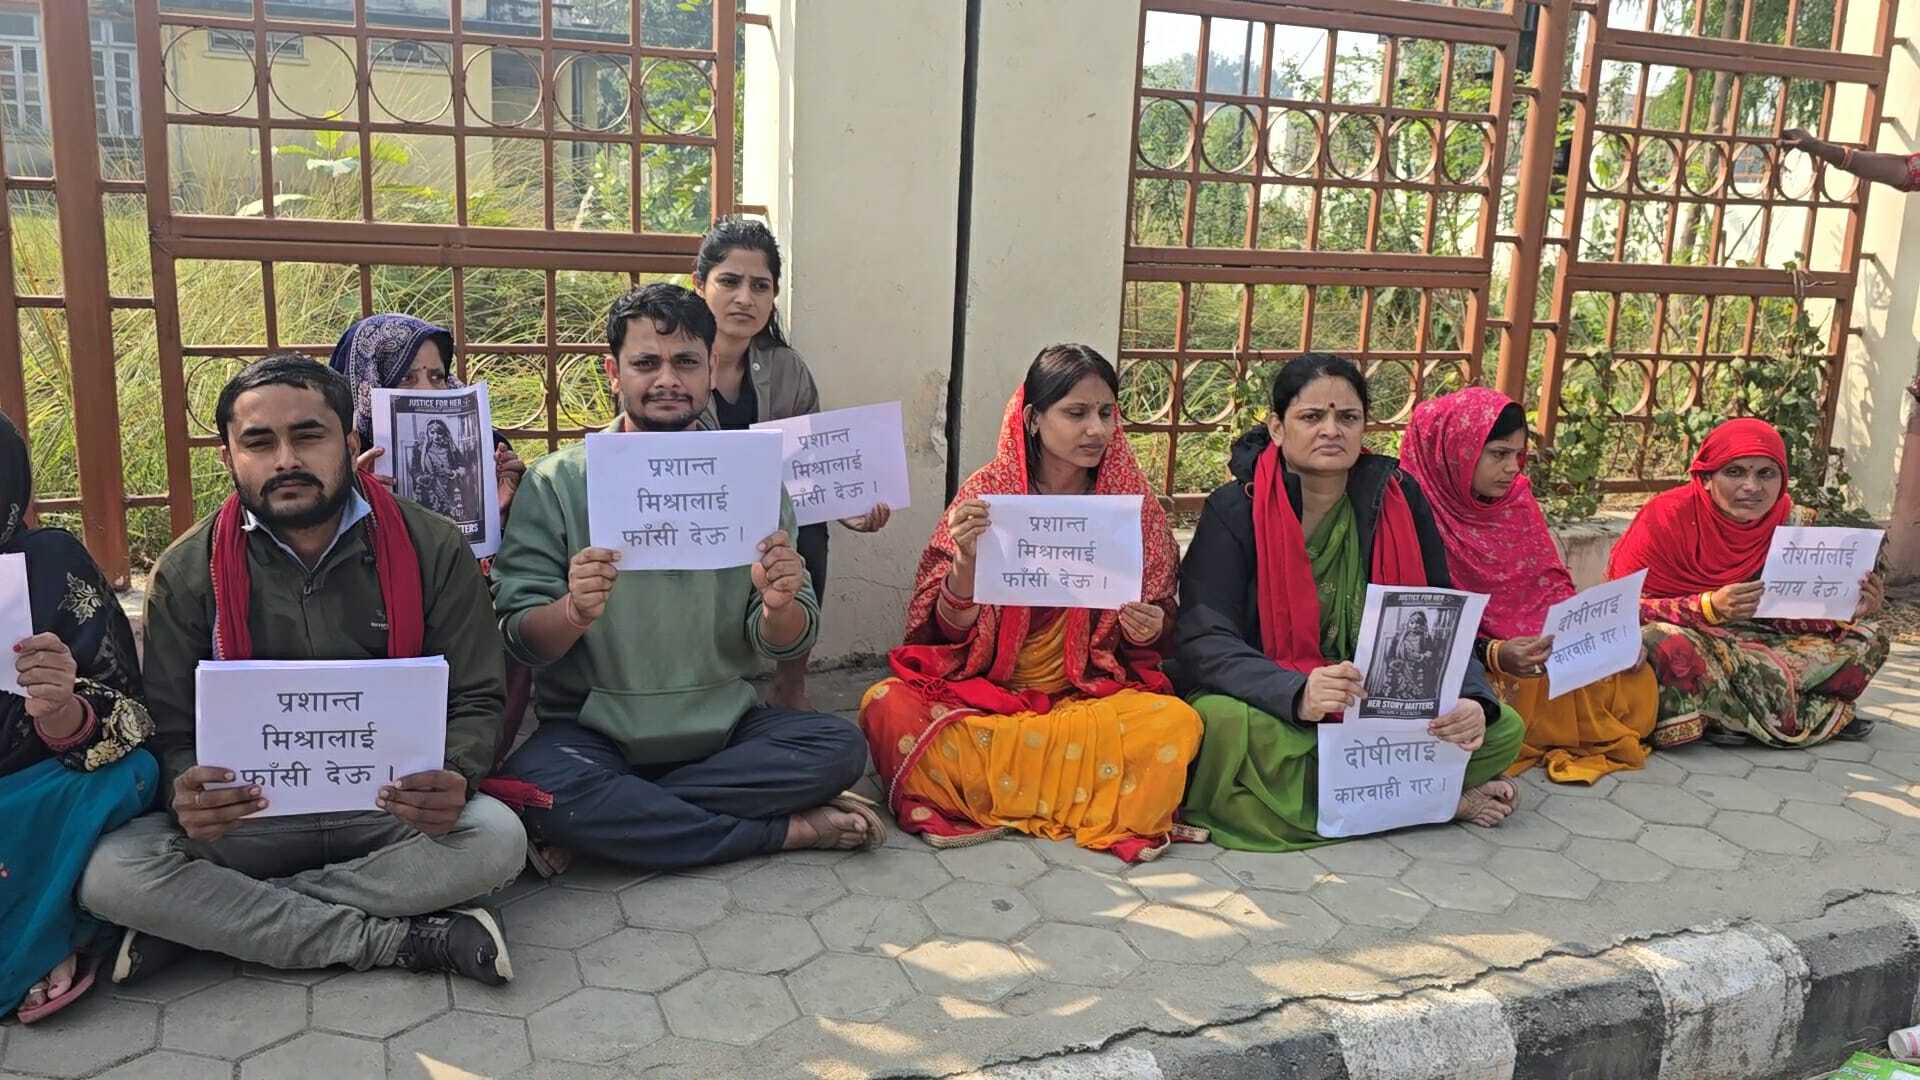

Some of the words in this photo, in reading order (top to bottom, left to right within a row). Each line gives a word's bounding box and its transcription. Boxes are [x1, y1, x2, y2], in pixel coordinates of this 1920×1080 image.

[409, 399, 434, 409] JUSTICE
[435, 399, 448, 409] FOR
[450, 399, 462, 408] HER
[798, 428, 850, 450] प्रशान्त
[648, 456, 717, 477] प्रशान्त
[792, 449, 863, 480] मिश्रालाई
[637, 485, 729, 513] मिश्रालाई
[833, 481, 864, 499] देऊ
[622, 522, 679, 547] फाँसी
[689, 522, 729, 546] देऊ
[1029, 516, 1088, 532] प्रशान्त
[1017, 538, 1097, 565] मिश्रालाई
[1781, 541, 1858, 568] रोशनीलाई
[1002, 567, 1049, 588] फाँसी
[1059, 568, 1094, 589] देऊ
[1768, 580, 1807, 597] न्याय
[1812, 576, 1843, 598] देऊ
[1552, 632, 1595, 664] कारवाही
[277, 690, 363, 713] प्रशान्त
[1367, 700, 1381, 708] HER
[1382, 700, 1404, 709] STORY
[1404, 702, 1434, 710] MATTERS
[262, 721, 377, 751] मिश्रालाई
[240, 761, 311, 788] फाँसी
[325, 760, 375, 785] देऊ
[1334, 776, 1401, 804] कारवाही
[1409, 777, 1434, 795] गर
